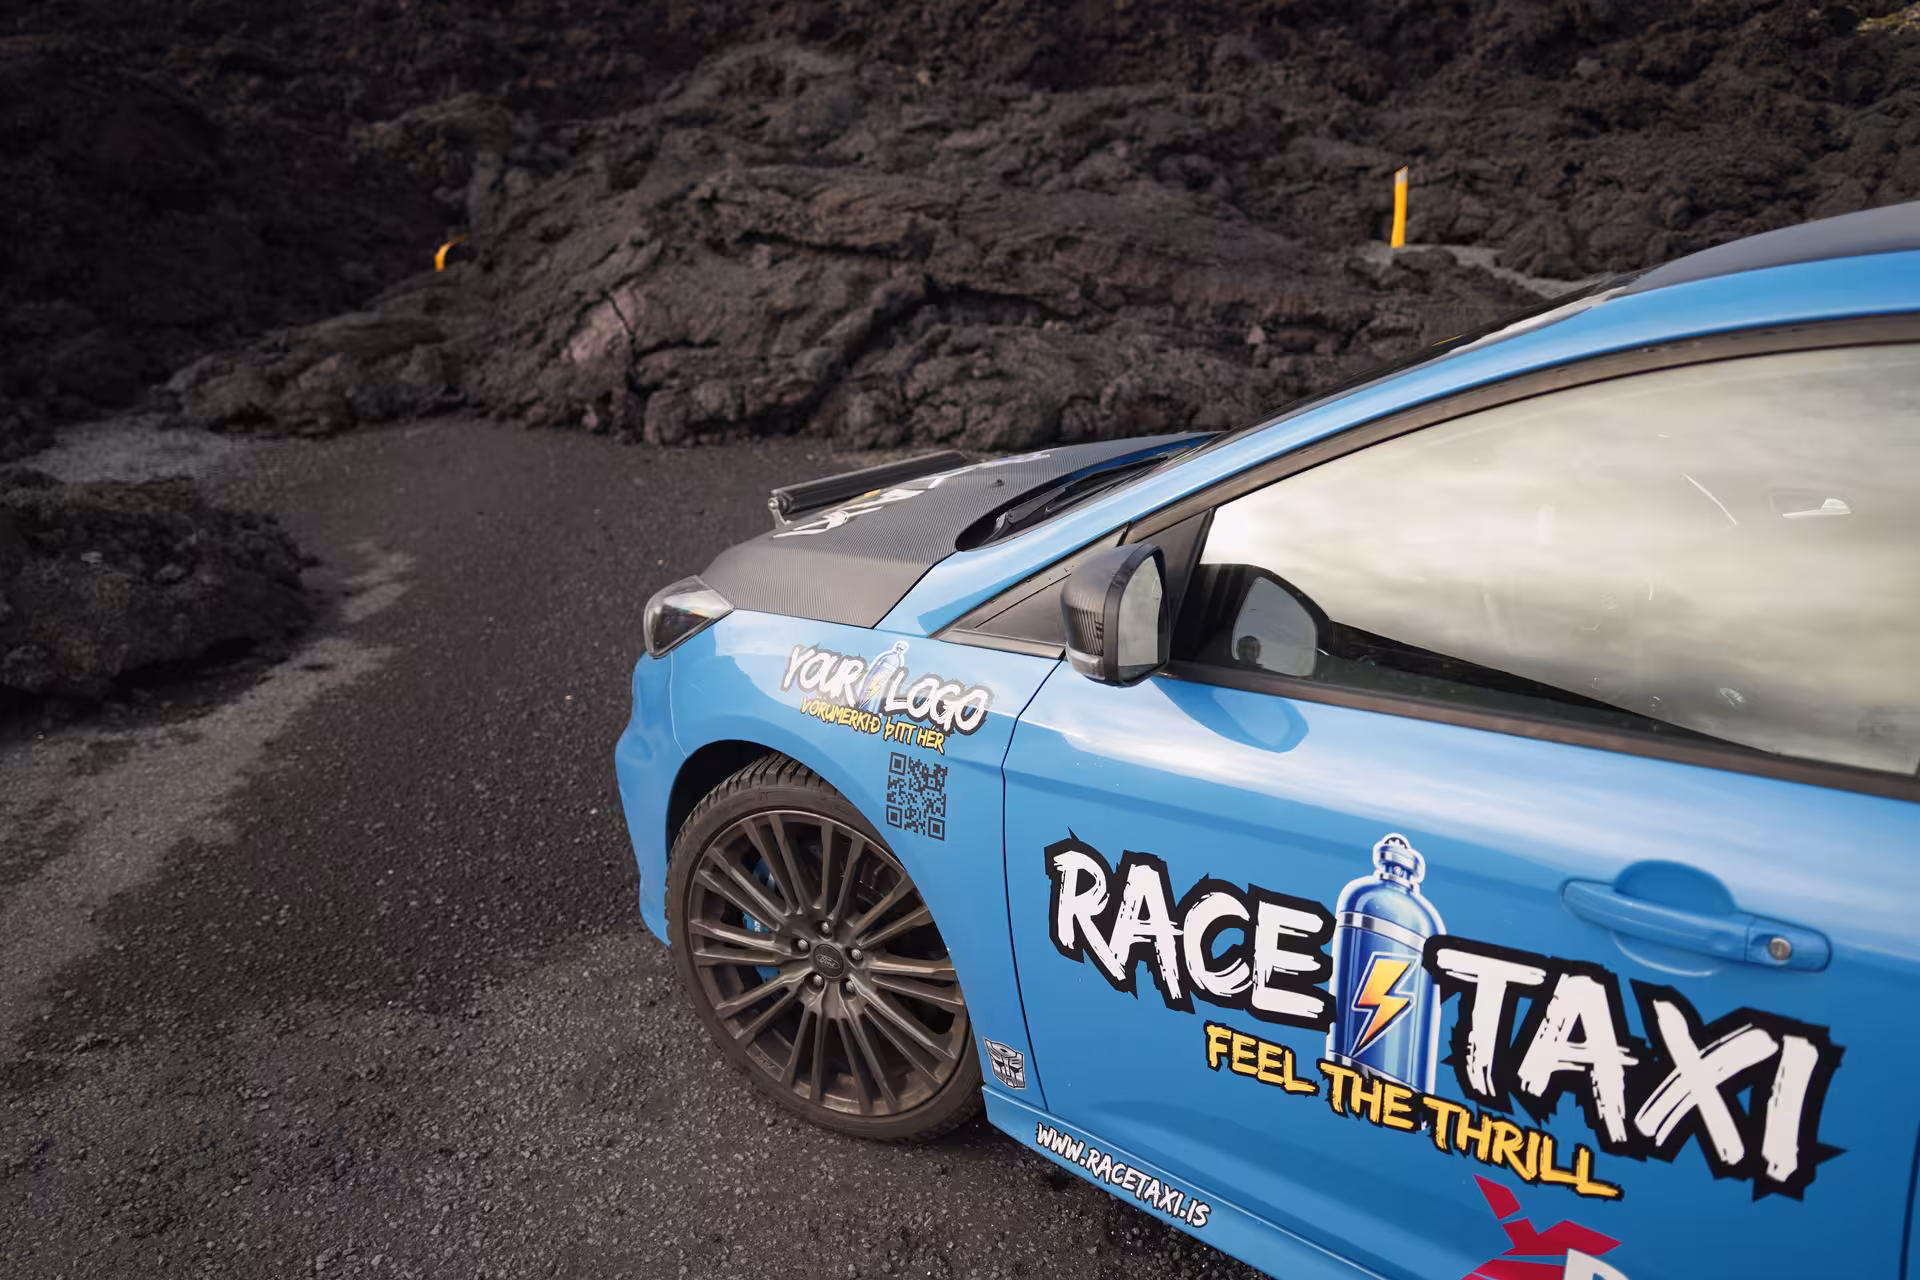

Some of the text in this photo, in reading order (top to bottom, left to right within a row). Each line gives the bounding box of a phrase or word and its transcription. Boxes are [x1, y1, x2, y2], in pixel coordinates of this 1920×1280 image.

[783, 645, 989, 731] YOUR LOGO
[801, 696, 945, 754] VÖRUMERKIÐ ÞITT HÉR
[1051, 848, 1820, 1183] RACE TAXI
[1205, 1023, 1620, 1198] FEEL THE THRILL
[1035, 1122, 1211, 1228] WWW.RACETAXI.IS
